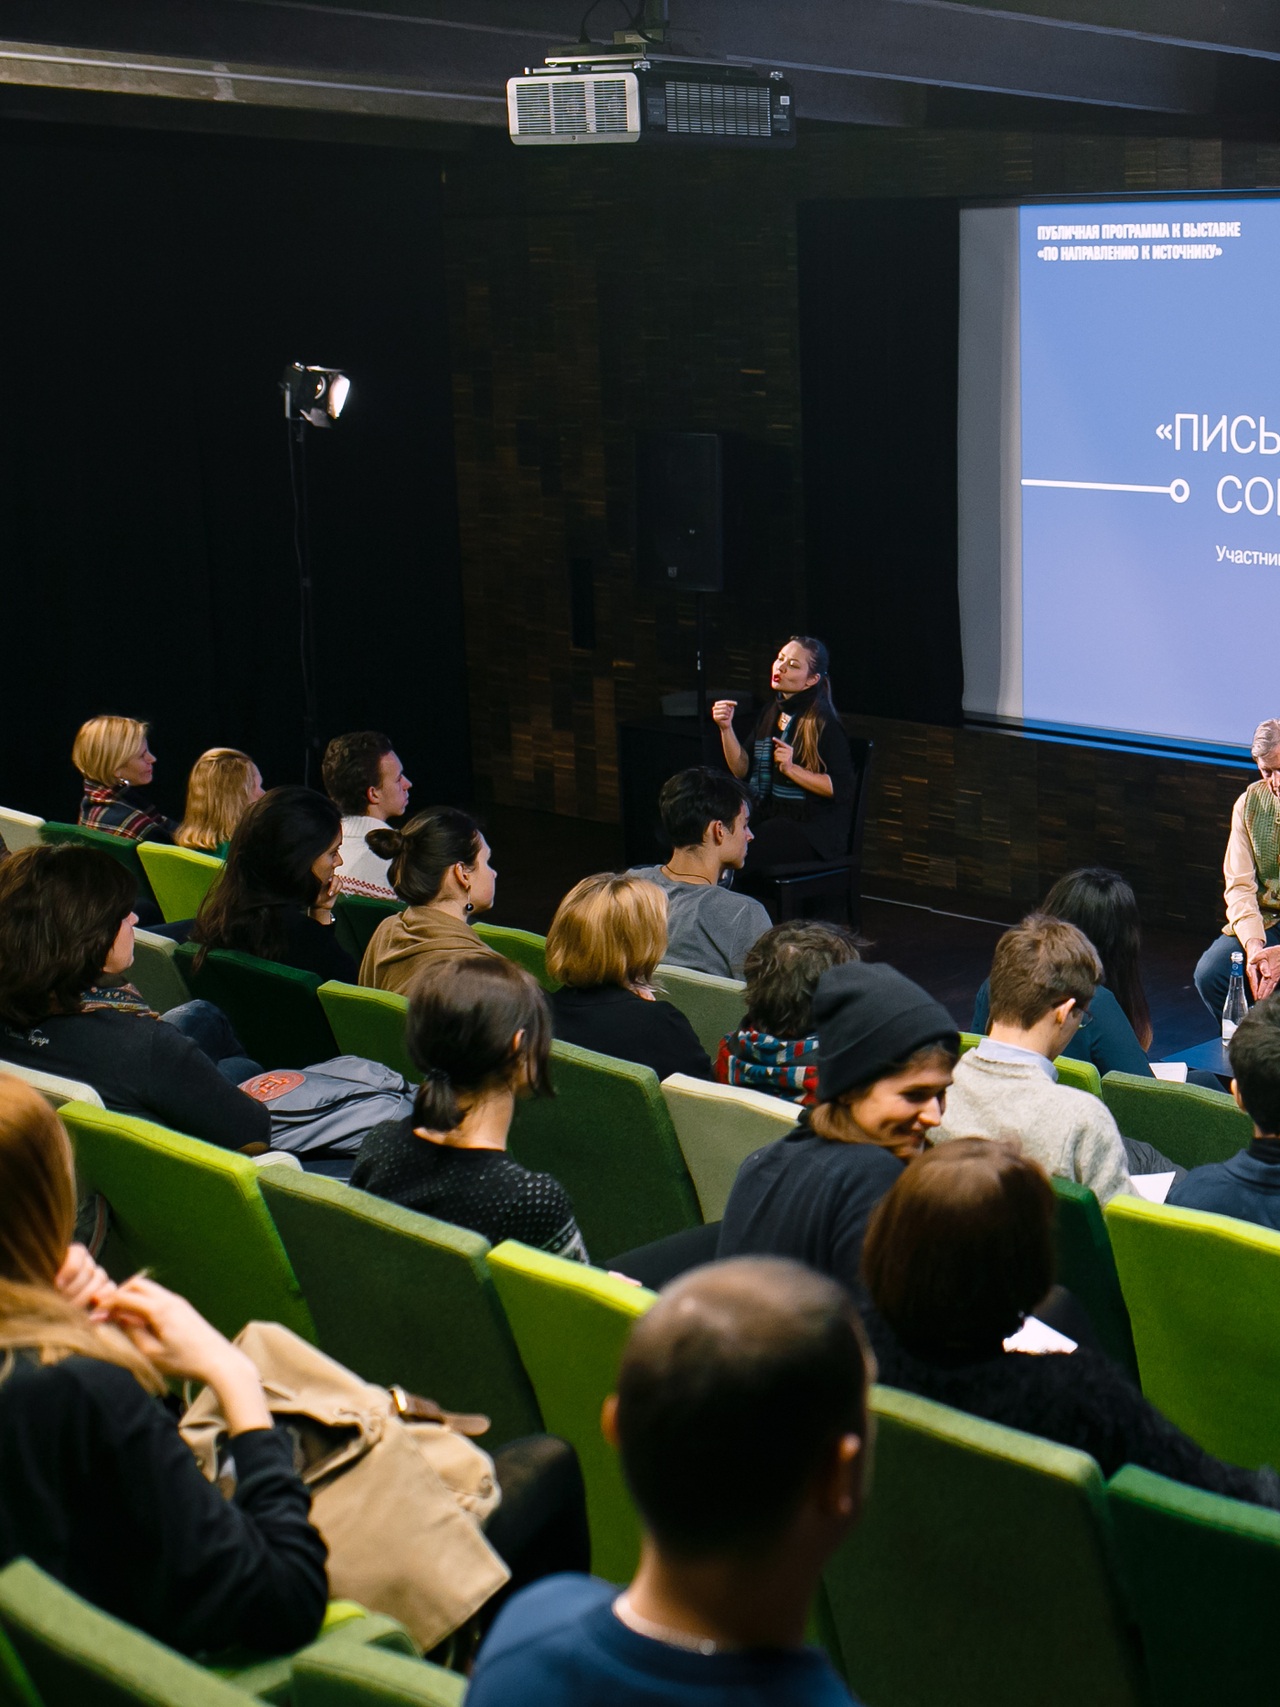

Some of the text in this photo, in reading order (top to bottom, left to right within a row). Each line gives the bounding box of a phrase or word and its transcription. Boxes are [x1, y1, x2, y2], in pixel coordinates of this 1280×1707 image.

[1037, 221, 1241, 240] ПУБЛИЧНАЯ ПРОГРАММА К ВЫСТАВКЕ
[1037, 244, 1223, 261] «ПО НАПРАВЛЕНИЮ К ИСТОЧНИКУ»
